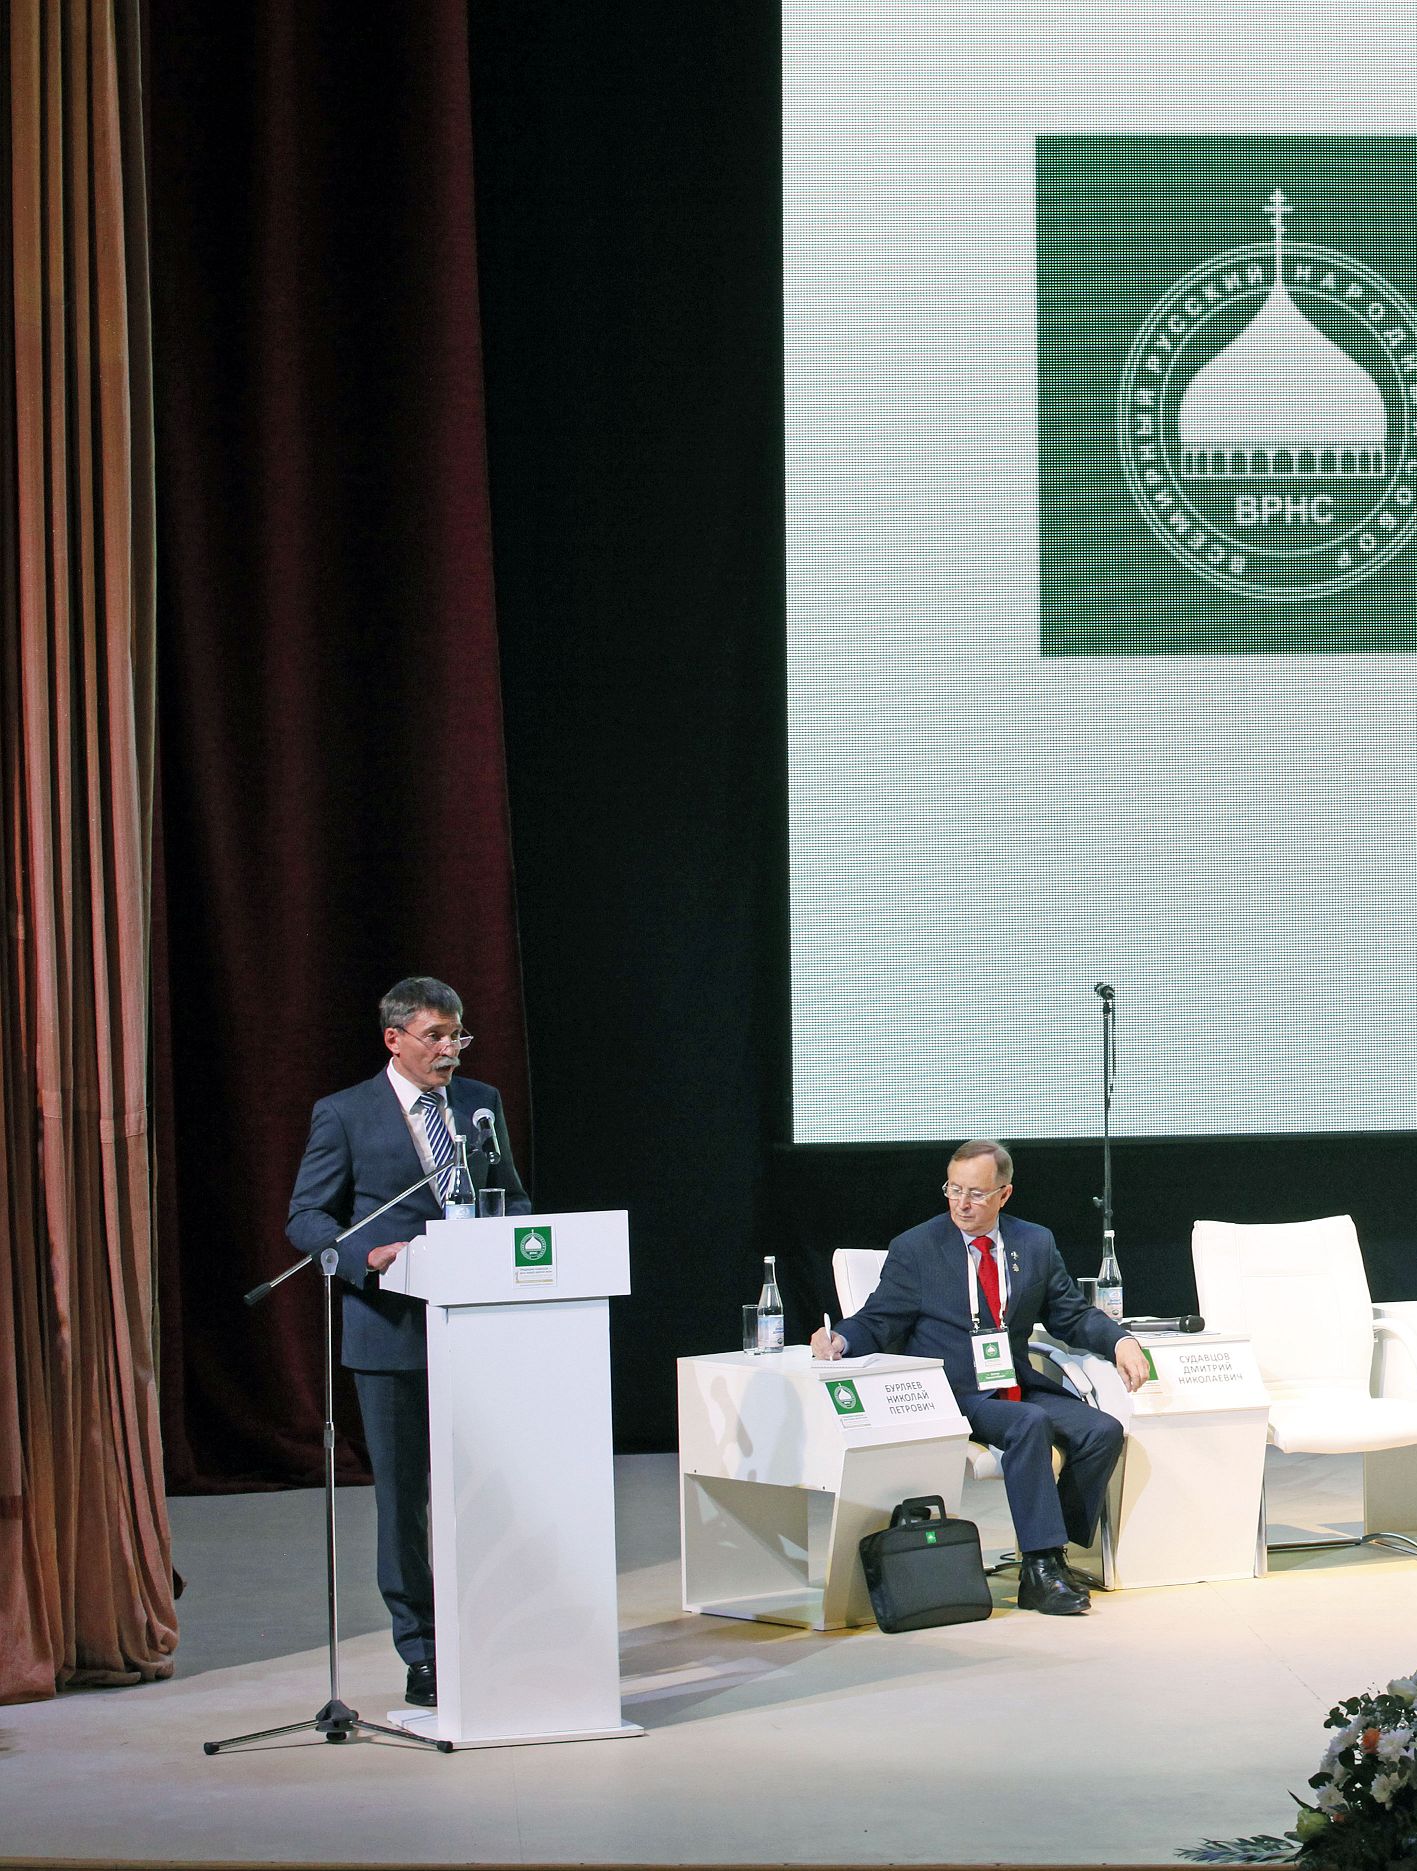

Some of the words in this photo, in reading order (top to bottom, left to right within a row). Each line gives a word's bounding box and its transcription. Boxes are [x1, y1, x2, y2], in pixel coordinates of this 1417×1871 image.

[1145, 263, 1265, 375] РУССКИЙ
[1136, 387, 1247, 575] ВСЕМИРНЫЙ
[1234, 493, 1335, 527] ВРНС
[1179, 1352, 1231, 1364] СУДАВЦОВ
[1183, 1361, 1233, 1375] ДМИТРИЙ
[1178, 1372, 1243, 1385] НИКОЛАЕВИЧ
[884, 1381, 923, 1393] БУРЛЯЕВ
[886, 1389, 930, 1404] НИКОЛАЙ
[889, 1403, 936, 1415] ПЕТРОВИЧ
